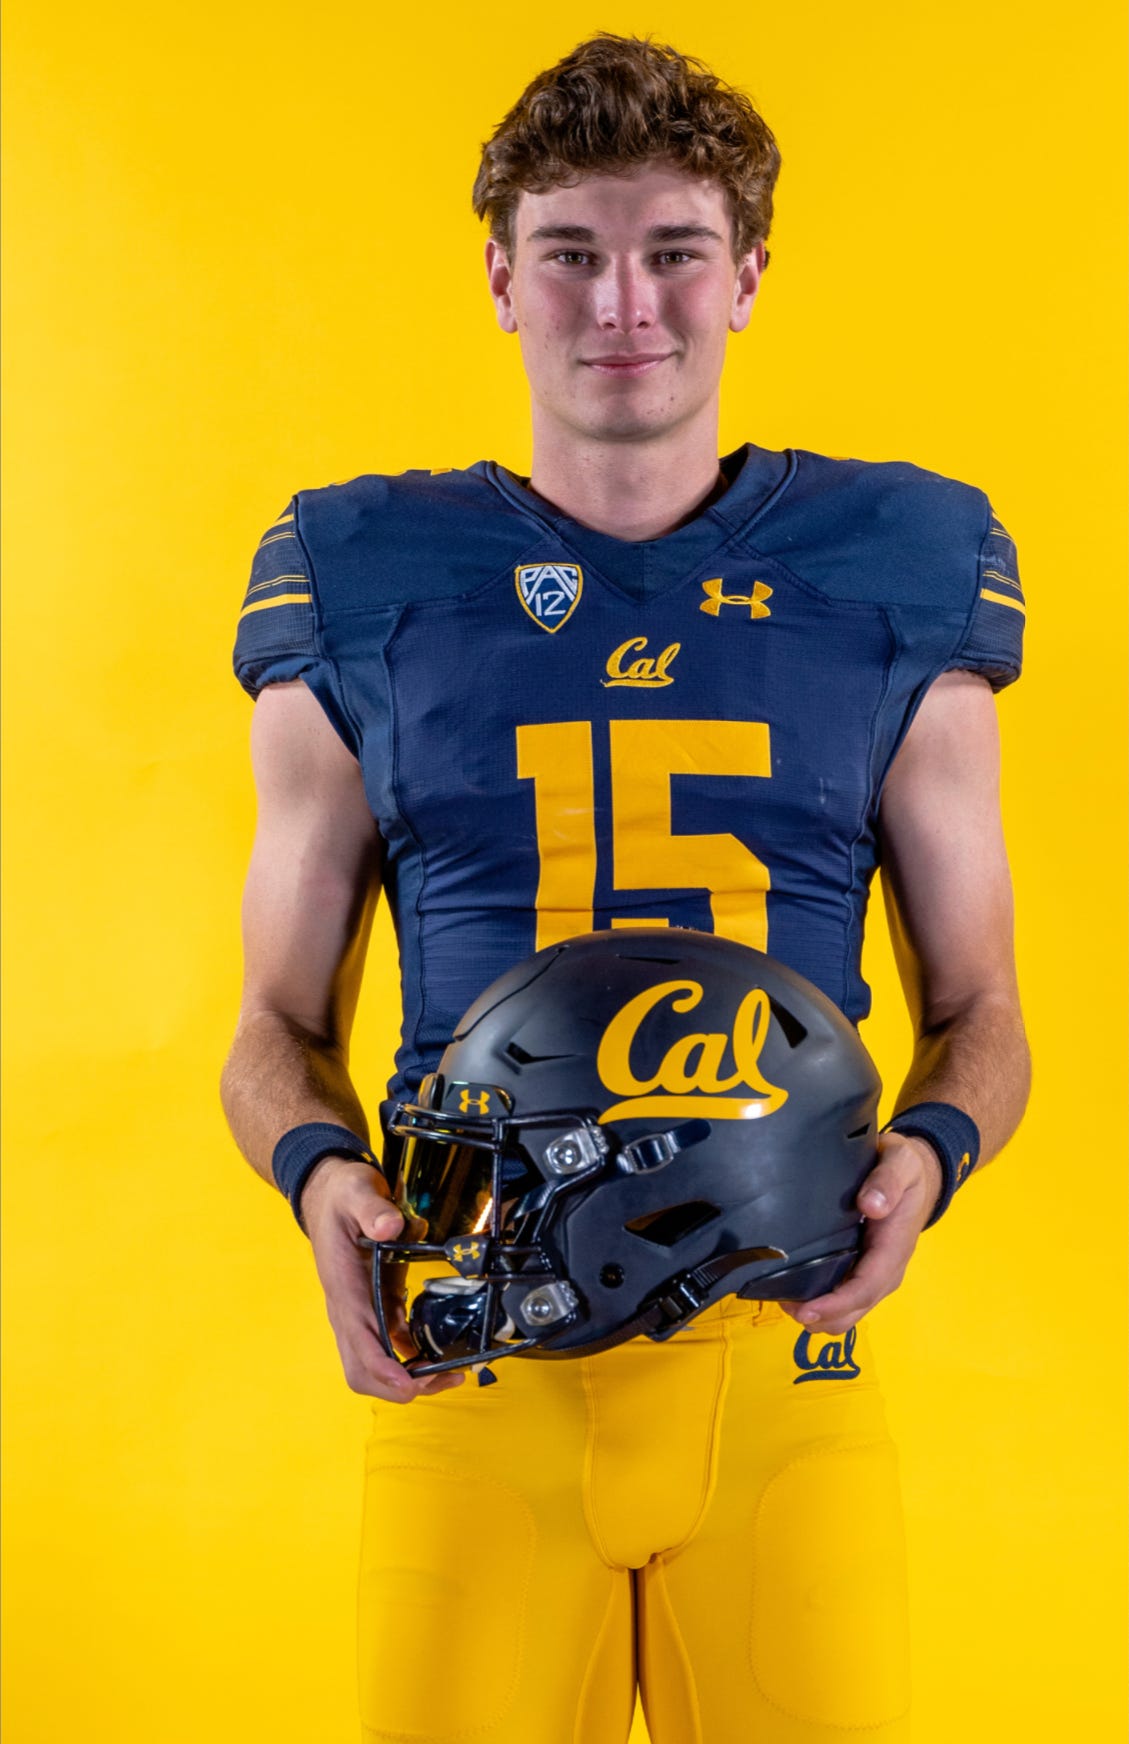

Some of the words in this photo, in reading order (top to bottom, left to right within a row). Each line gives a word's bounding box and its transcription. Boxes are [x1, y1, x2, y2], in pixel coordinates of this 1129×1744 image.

[519, 564, 579, 605] PAC
[535, 591, 566, 617] 12
[604, 636, 681, 688] Cal
[516, 719, 772, 954] 15
[597, 979, 789, 1125] Cal
[793, 1325, 861, 1385] Cal
